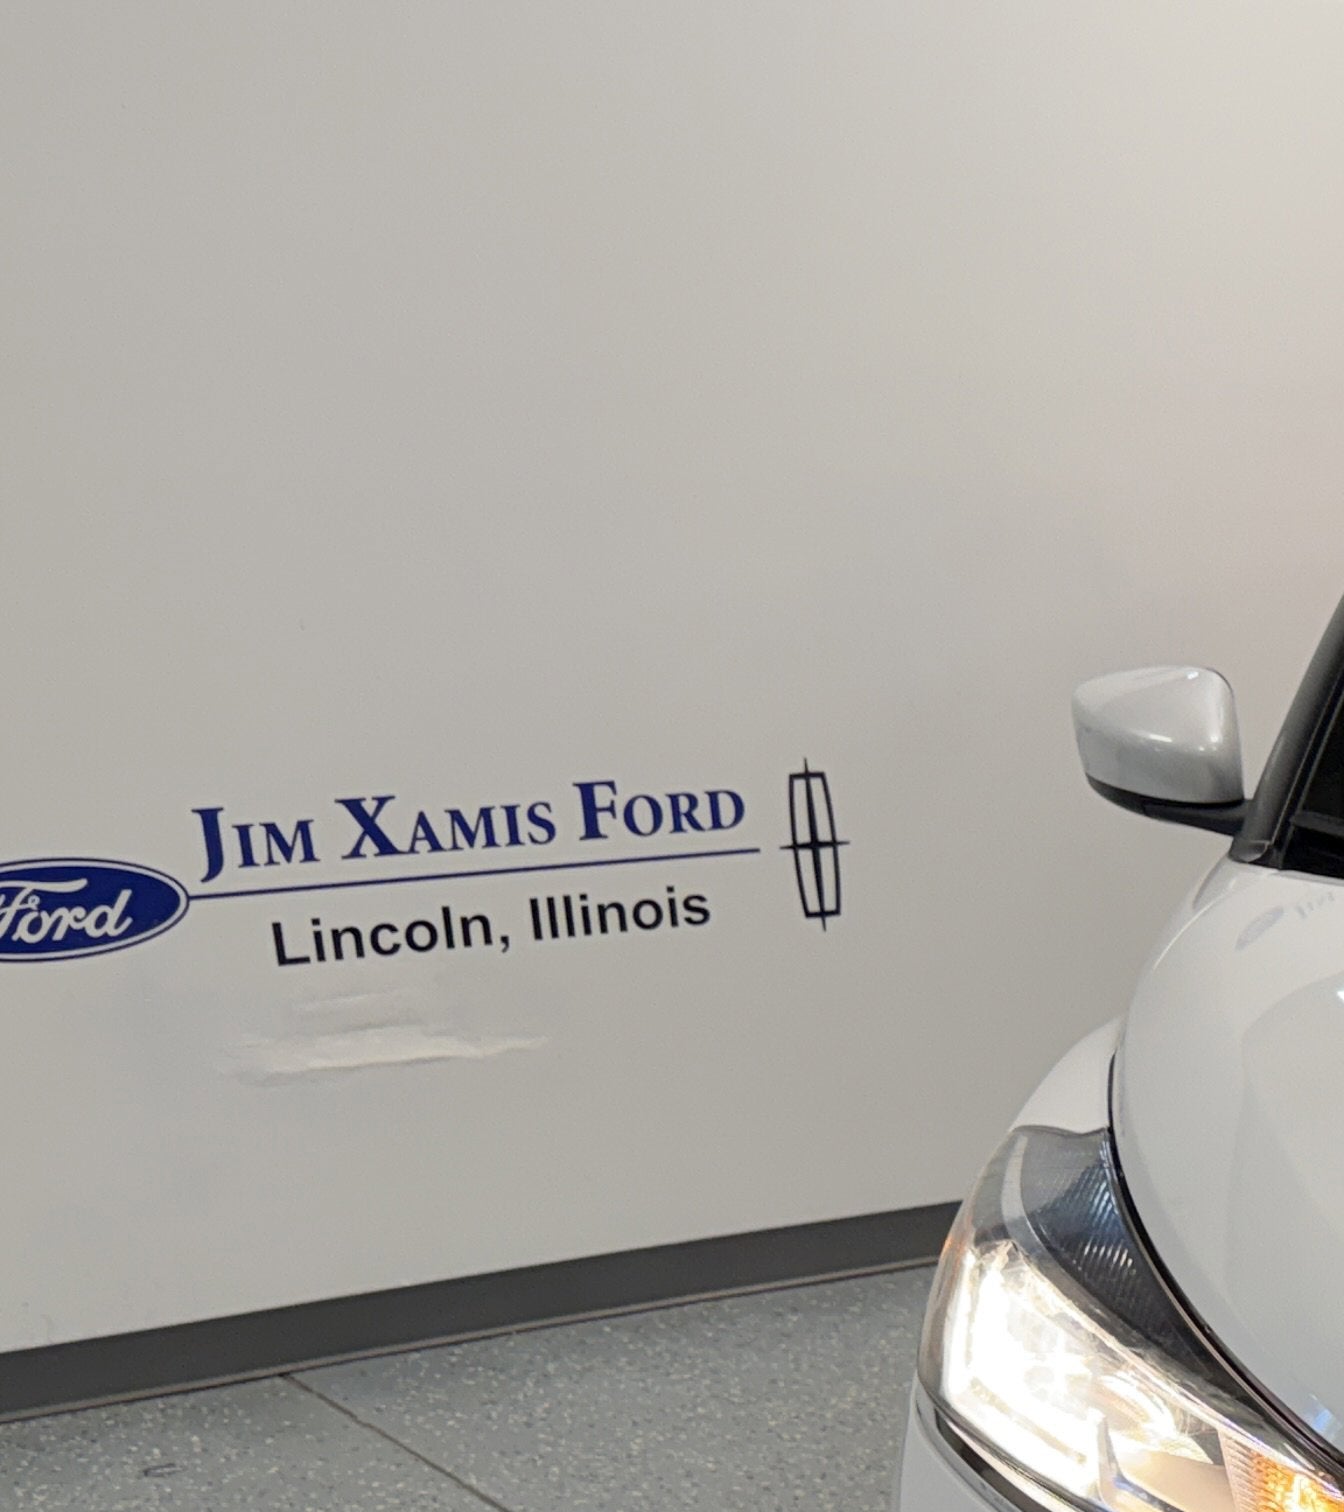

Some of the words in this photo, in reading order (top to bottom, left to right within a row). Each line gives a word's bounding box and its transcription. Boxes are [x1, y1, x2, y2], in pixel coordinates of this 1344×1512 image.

[191, 804, 321, 884] JIM
[334, 794, 558, 860] XAMIS
[572, 778, 746, 842] FORD
[271, 904, 511, 968] Lincoln,
[528, 883, 713, 944] Illinois
